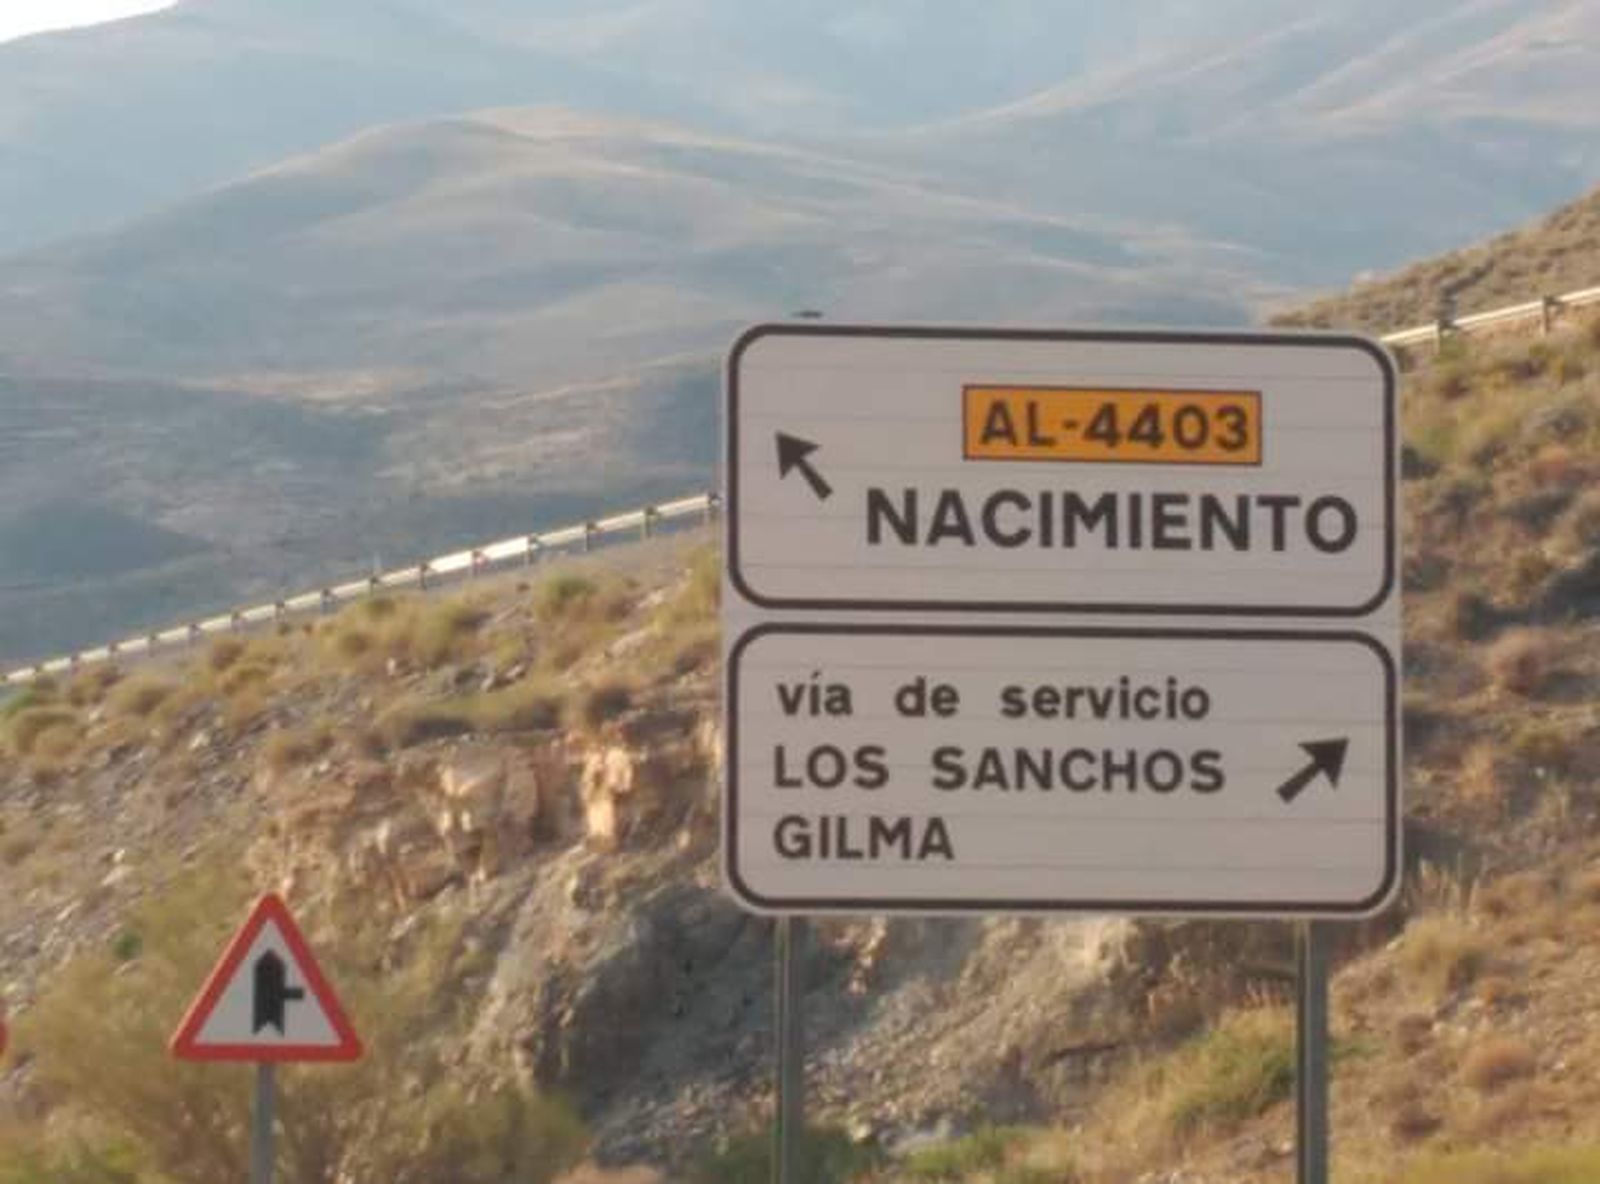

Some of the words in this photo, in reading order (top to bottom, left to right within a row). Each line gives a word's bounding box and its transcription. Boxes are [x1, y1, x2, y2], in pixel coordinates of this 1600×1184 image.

[978, 398, 1250, 453] AL-4403
[866, 487, 1358, 554] NACIMIENTO
[776, 670, 853, 717] vía
[894, 676, 960, 718] de
[1000, 676, 1211, 721] servicio
[774, 744, 890, 790] LOS
[931, 747, 1226, 794] SANCHOS
[773, 814, 955, 861] GILMA
